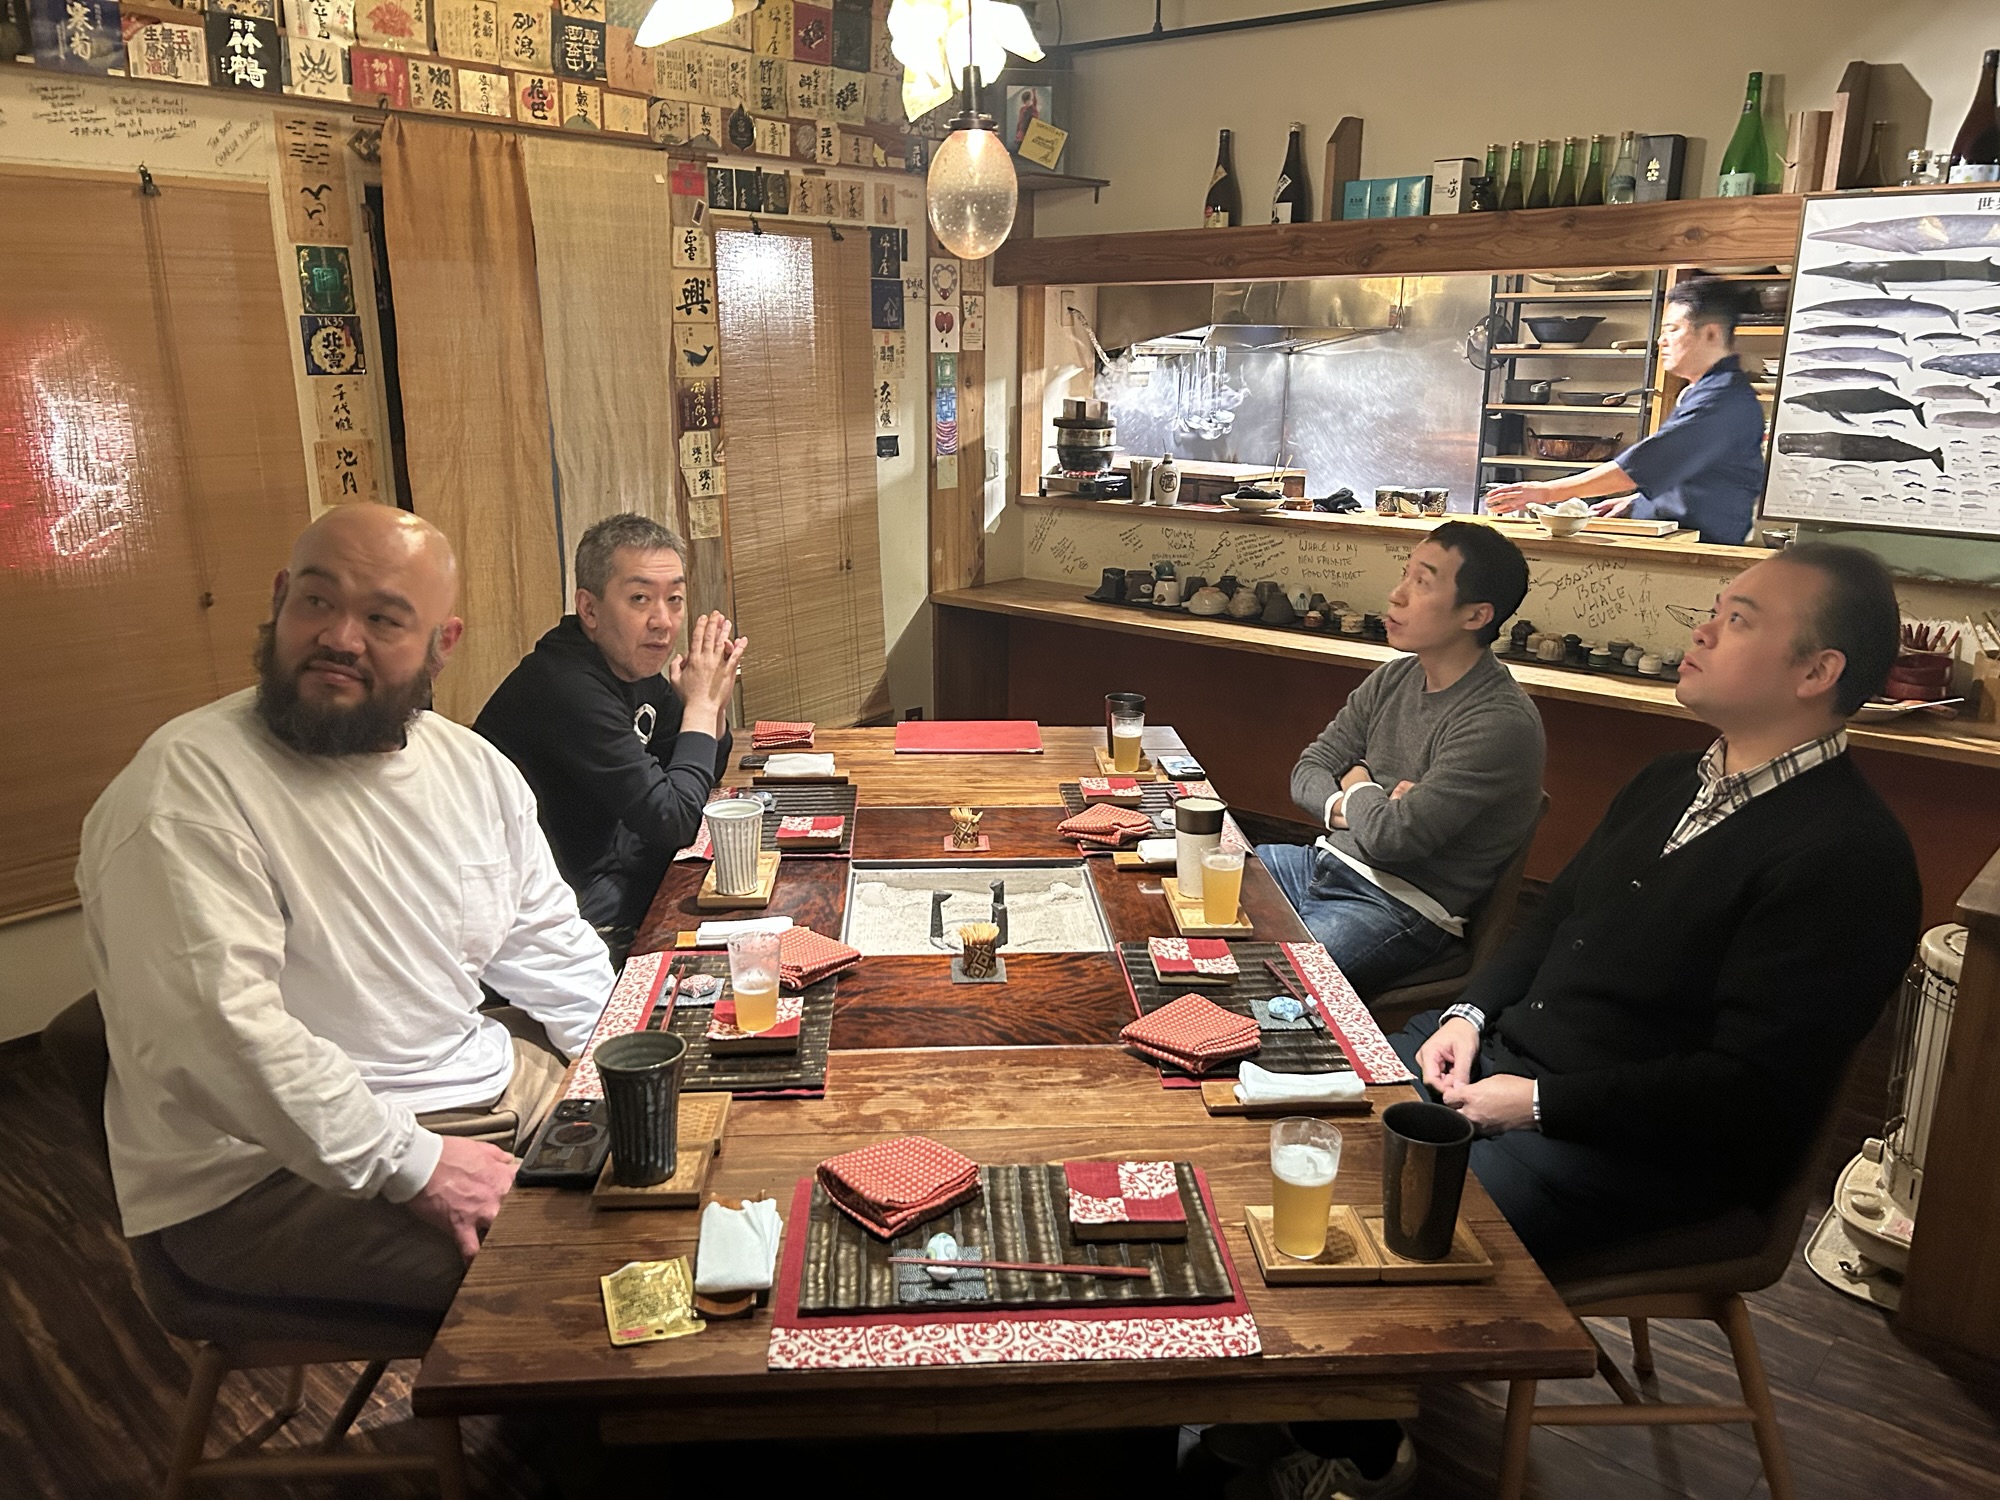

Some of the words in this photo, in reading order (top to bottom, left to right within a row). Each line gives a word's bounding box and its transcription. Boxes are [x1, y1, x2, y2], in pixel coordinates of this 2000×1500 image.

[174, 29, 192, 62] 玉村
[227, 31, 267, 88] 竹鶴
[528, 78, 548, 120] 花巴
[676, 276, 711, 316] 興
[317, 317, 344, 327] YK35
[322, 331, 346, 369] 北雪
[332, 383, 353, 431] 千代鶴
[335, 447, 358, 495] 池月
[1299, 539, 1327, 551] WHALE
[1346, 543, 1358, 557] MY
[1537, 558, 1627, 600] SEBASTIAN
[1576, 574, 1615, 600] BEST
[1572, 587, 1626, 619] WHALE
